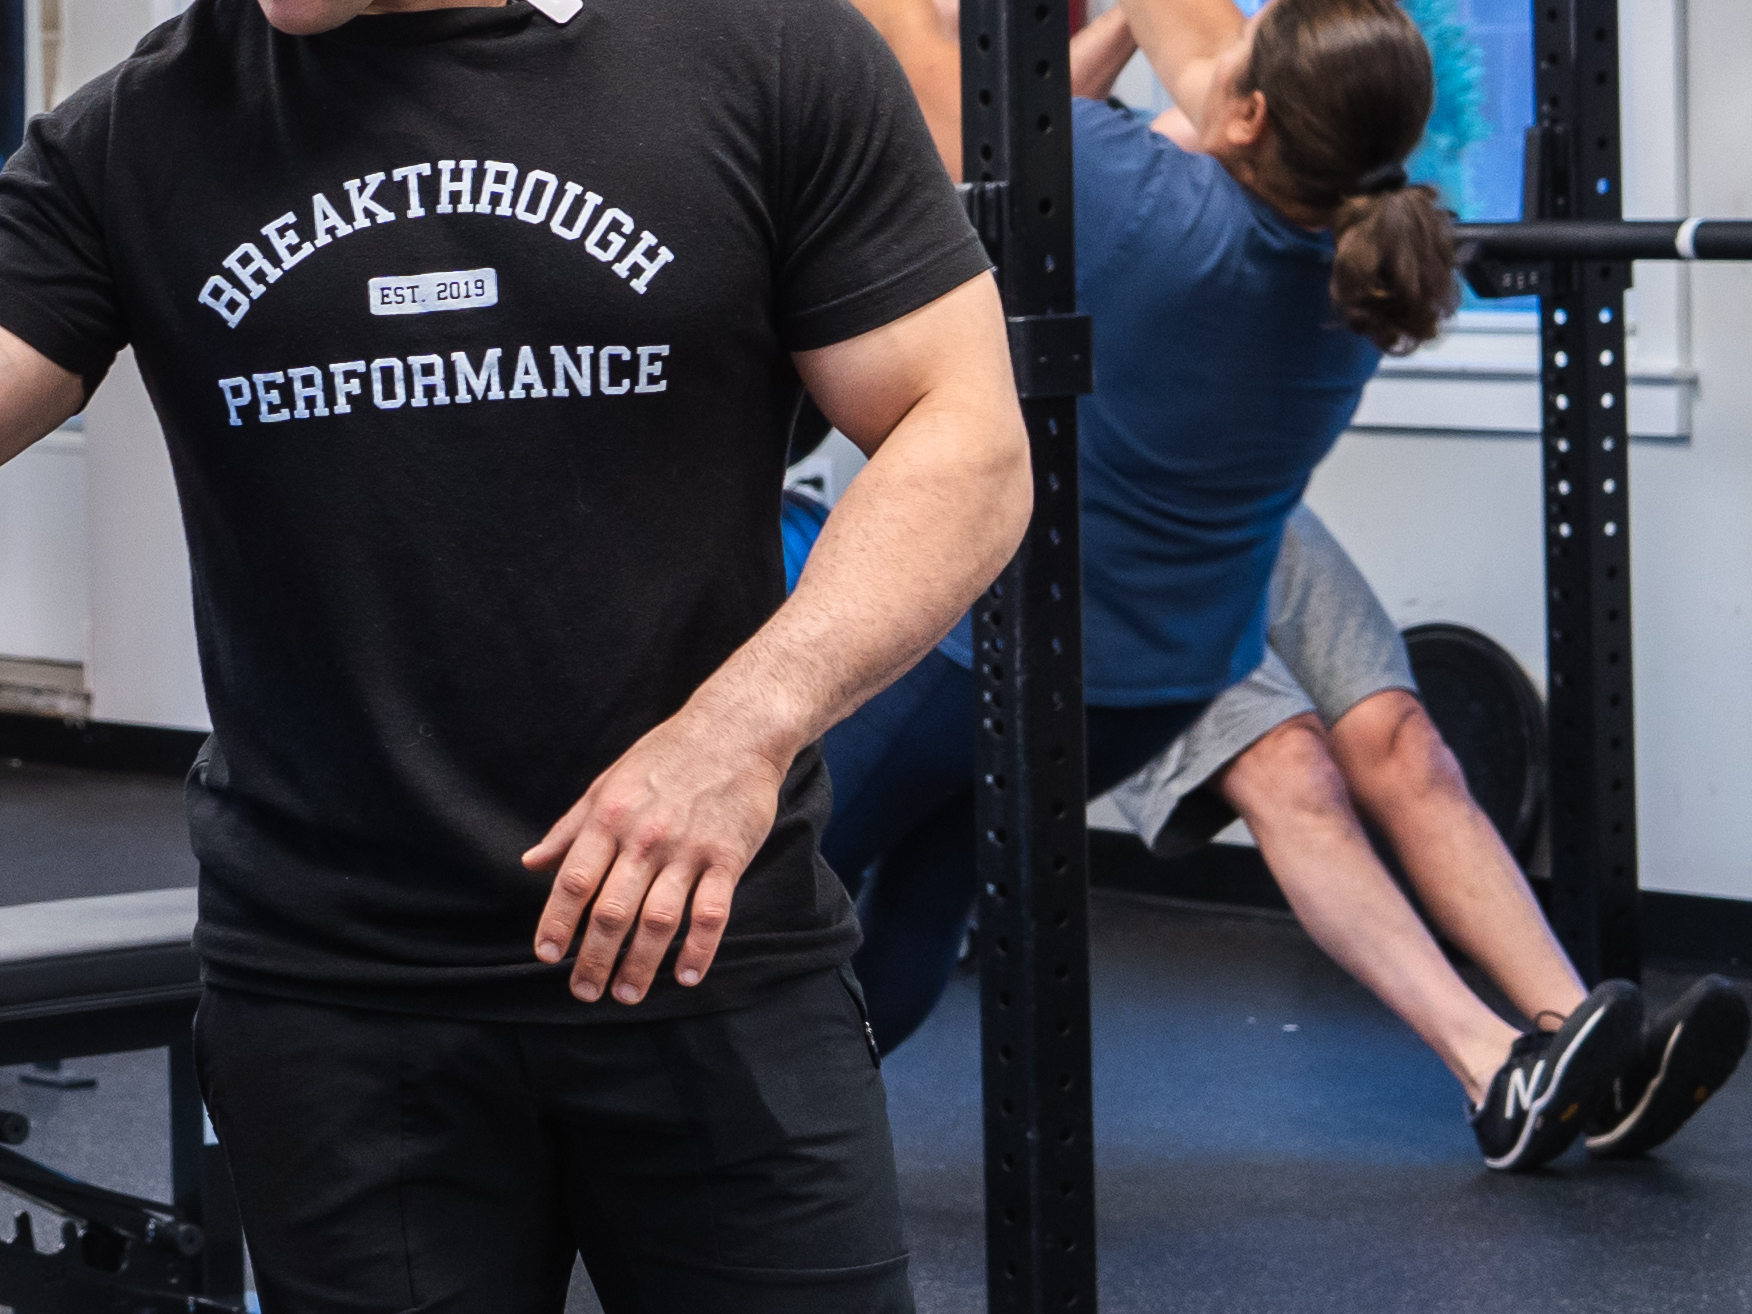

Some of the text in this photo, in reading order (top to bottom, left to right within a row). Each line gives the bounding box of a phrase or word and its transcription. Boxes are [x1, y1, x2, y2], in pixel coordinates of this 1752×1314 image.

[198, 160, 674, 328] BREAKTHROUGH
[379, 279, 485, 307] EST. 2019
[218, 344, 670, 426] PERFORMANCE
